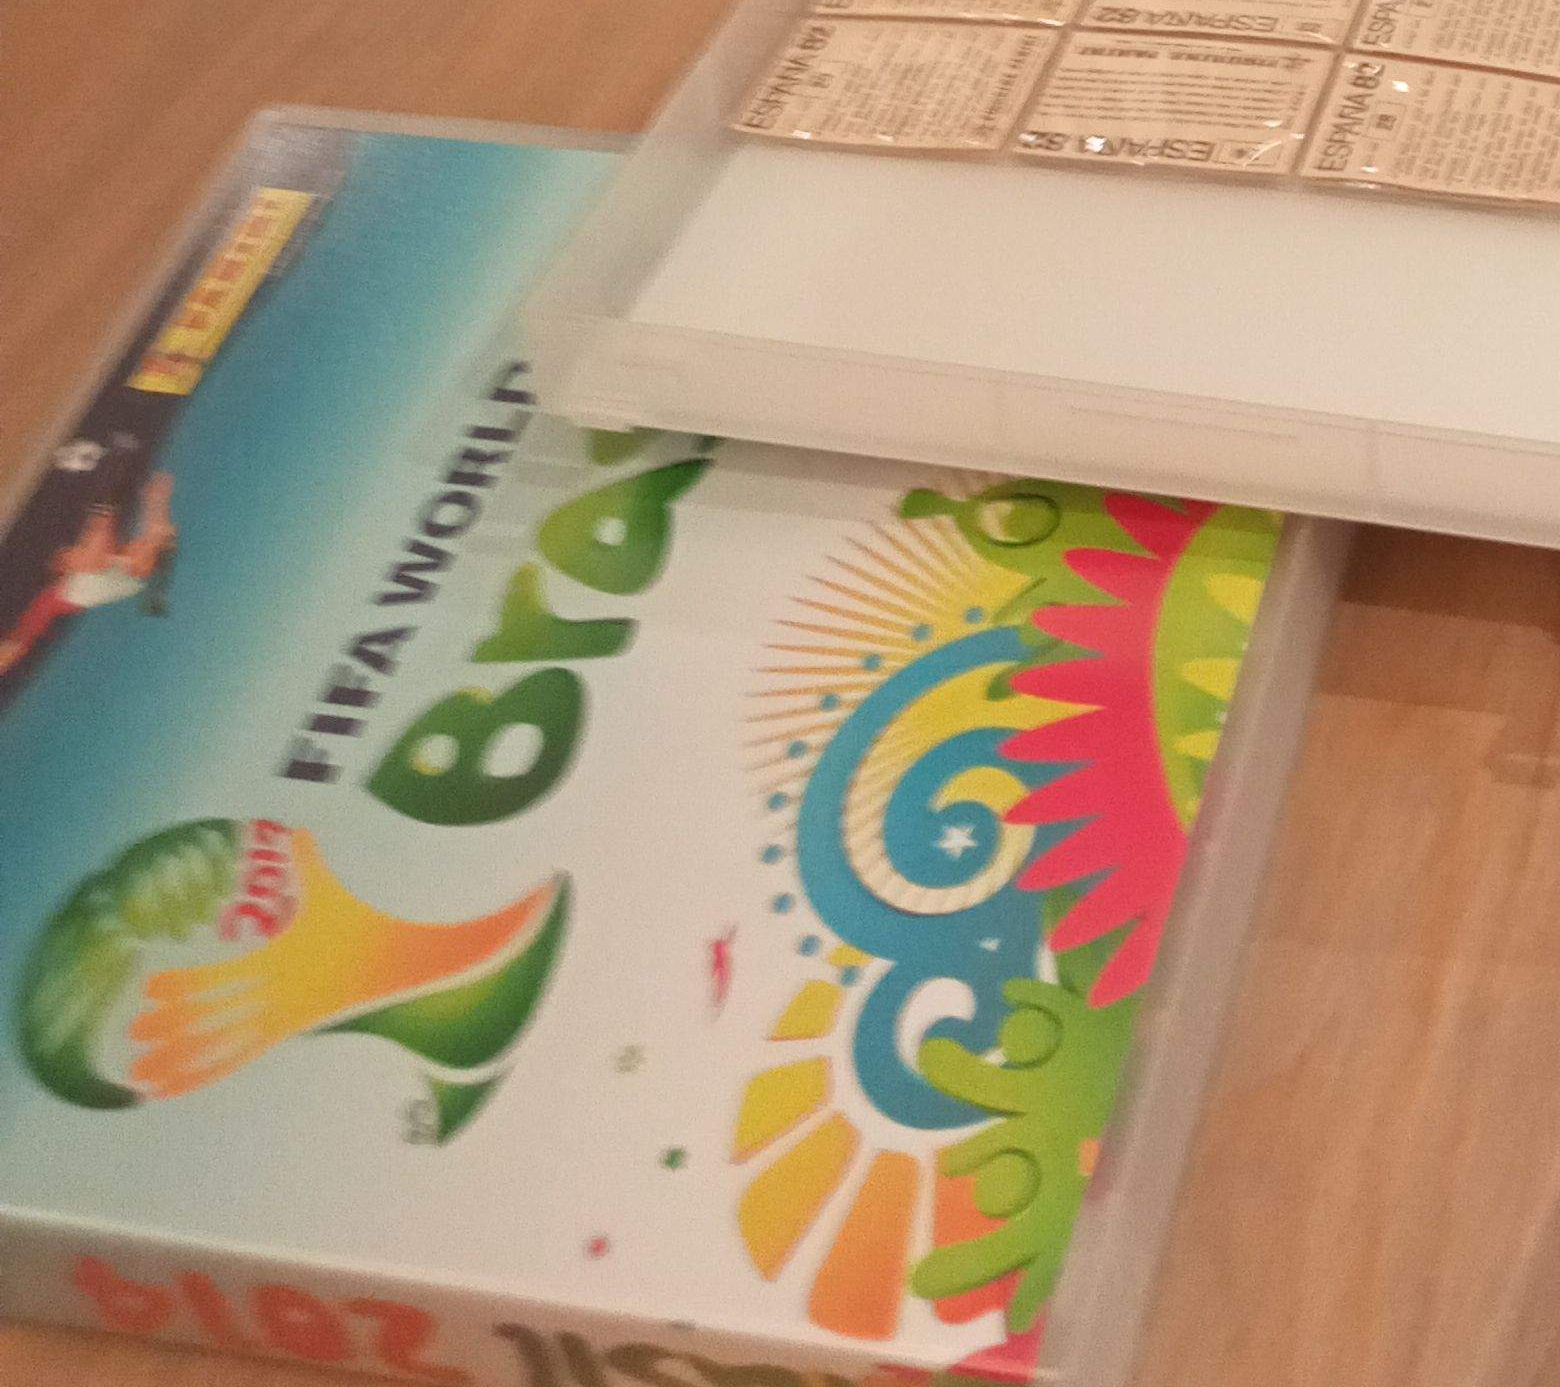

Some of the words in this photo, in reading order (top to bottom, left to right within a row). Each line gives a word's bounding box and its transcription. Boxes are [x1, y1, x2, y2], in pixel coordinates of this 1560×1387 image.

[1148, 10, 1277, 32] ESPAÑA
[1318, 94, 1373, 171] ESPAÑA
[277, 626, 418, 784] FIFA
